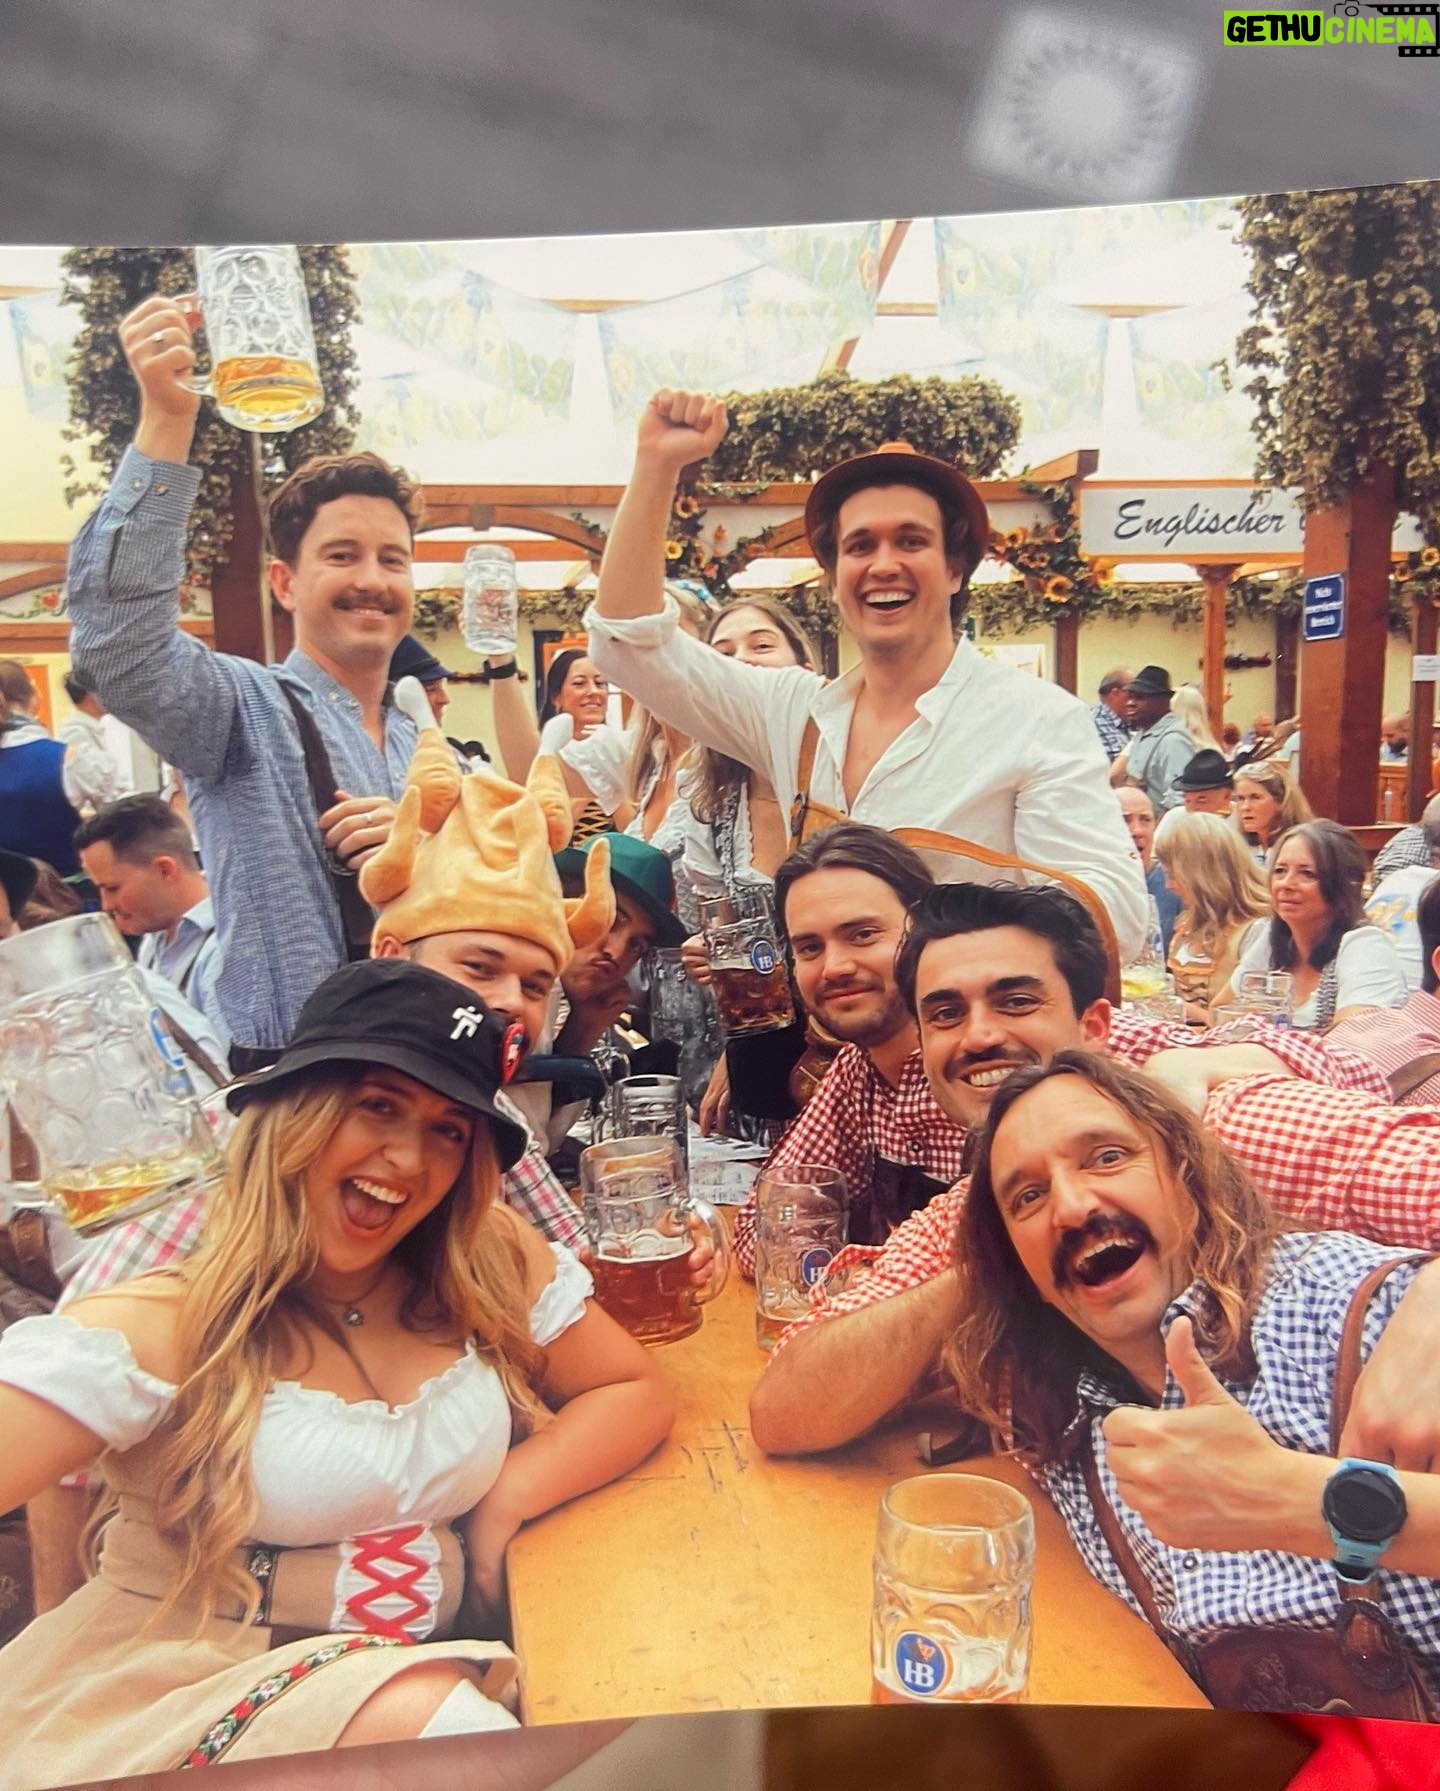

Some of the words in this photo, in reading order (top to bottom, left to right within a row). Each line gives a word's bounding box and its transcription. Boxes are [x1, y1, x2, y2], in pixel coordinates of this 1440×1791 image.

[1114, 499, 1285, 547] Englischer
[758, 955, 773, 970] HB
[904, 1658, 935, 1687] HB
